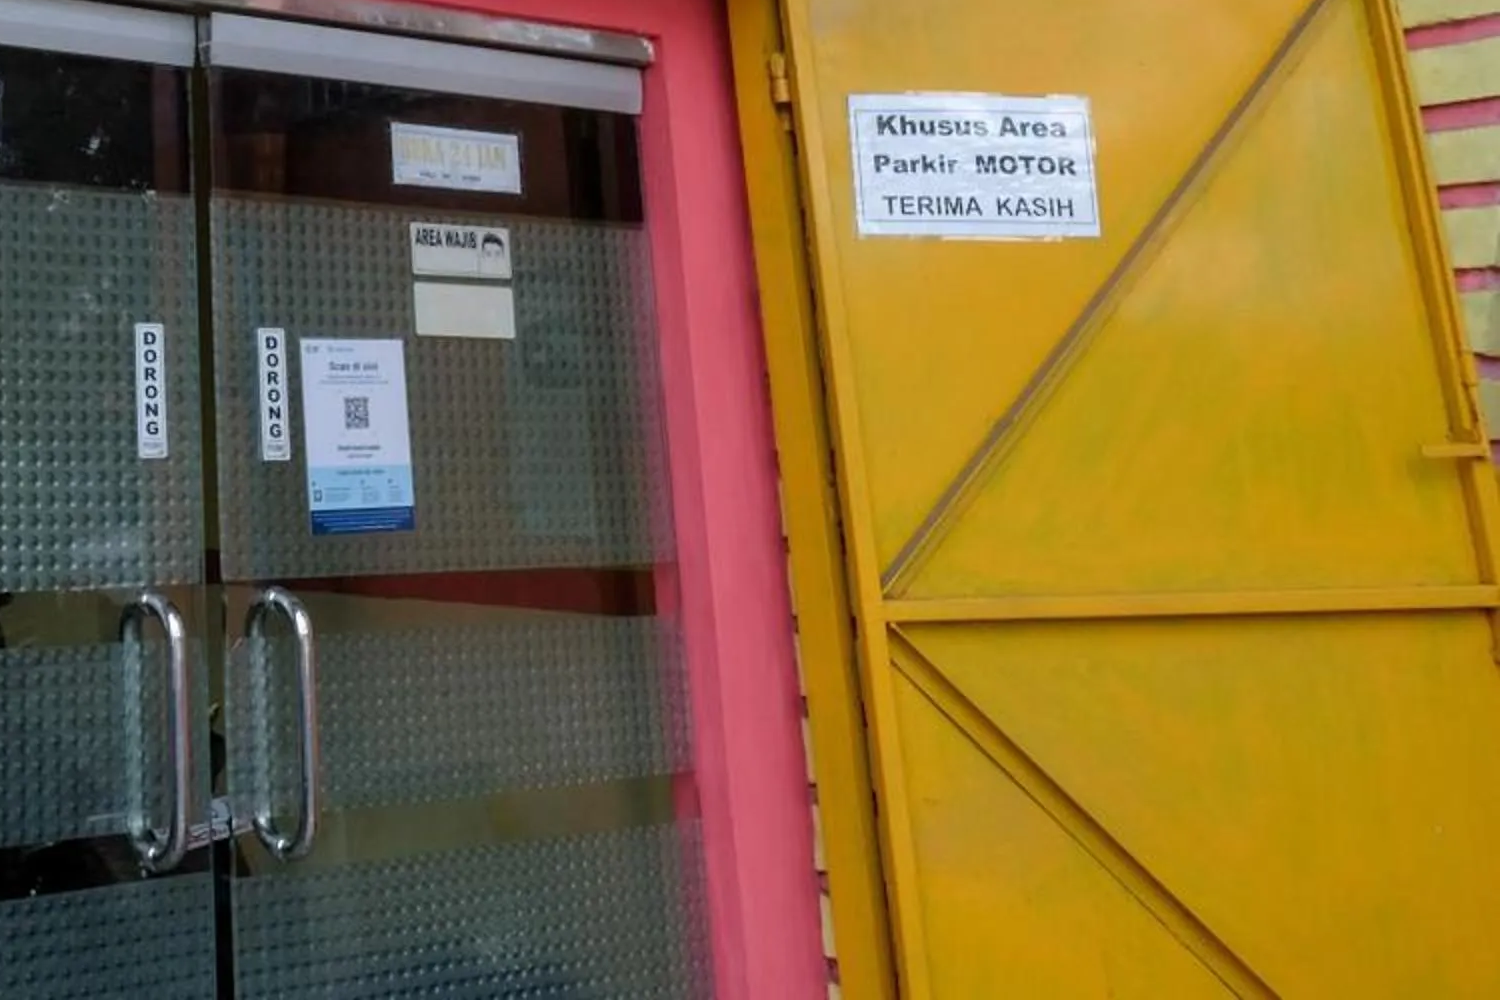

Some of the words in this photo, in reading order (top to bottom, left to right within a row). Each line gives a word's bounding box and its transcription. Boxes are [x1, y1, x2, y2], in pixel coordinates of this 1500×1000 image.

[876, 114, 989, 137] Khusus
[999, 116, 1067, 138] Area
[873, 154, 958, 174] Parkir
[975, 155, 1077, 175] MOTOR
[883, 195, 983, 216] TERIMA
[997, 196, 1074, 217] KASIH
[415, 228, 442, 247] AREA
[445, 230, 477, 249] WAJIB
[143, 331, 159, 435] DORONG
[265, 335, 282, 438] DORONG
